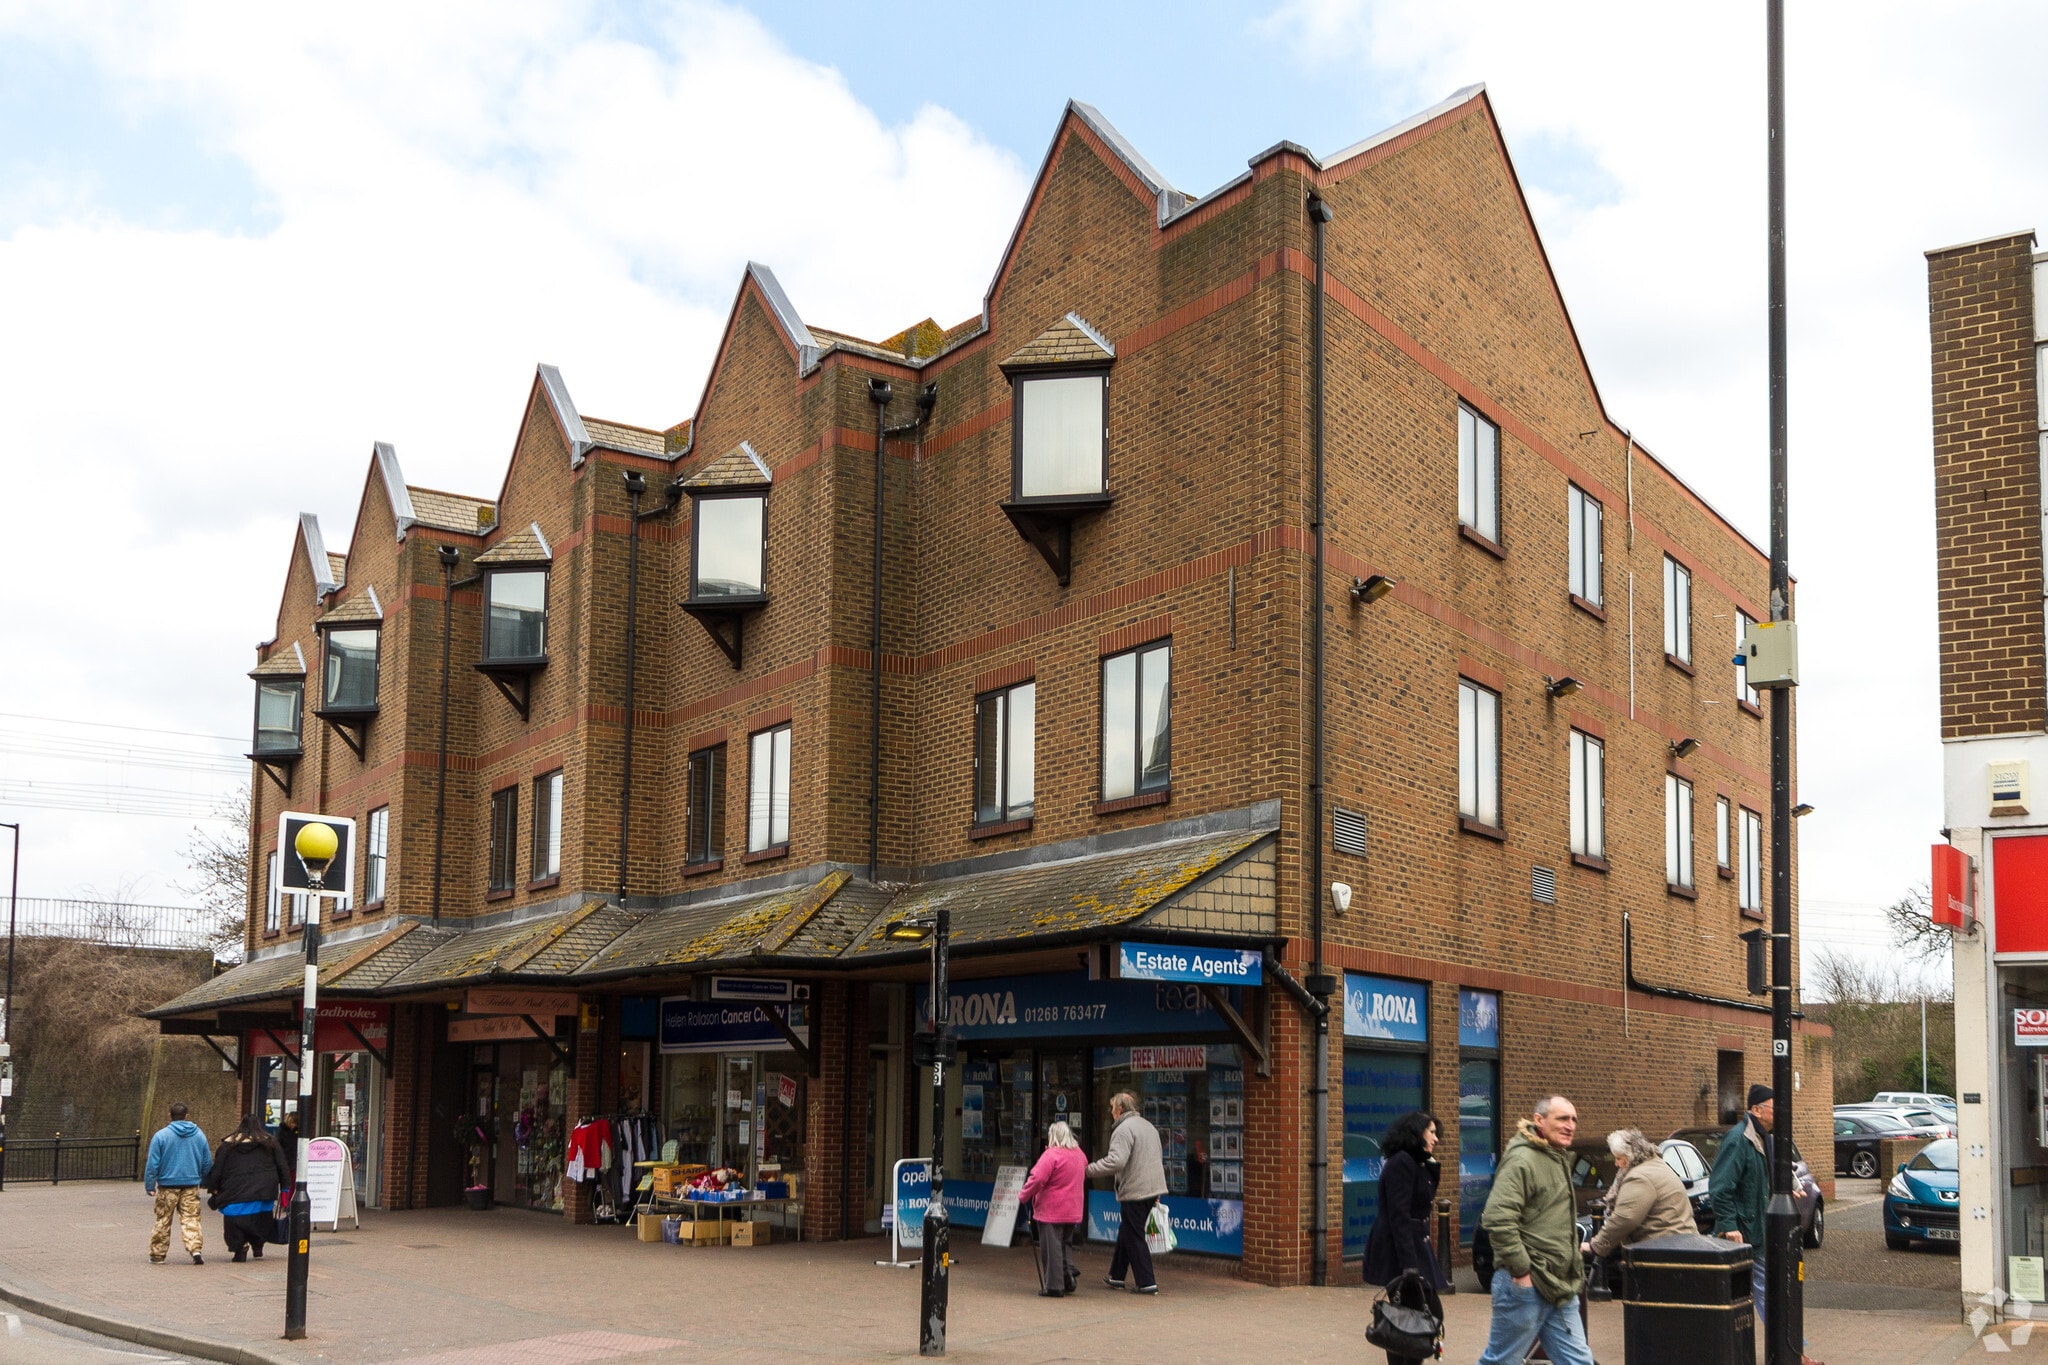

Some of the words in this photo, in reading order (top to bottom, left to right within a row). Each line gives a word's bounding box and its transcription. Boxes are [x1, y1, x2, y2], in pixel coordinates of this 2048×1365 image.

[1137, 951, 1187, 972] Estate
[1191, 954, 1248, 977] Agents
[315, 1006, 377, 1019] Ladbrokes
[664, 1012, 687, 1028] Helen
[688, 1010, 720, 1027] Rollason
[721, 1007, 752, 1024] Cancer
[948, 990, 1018, 1027] RONA
[1025, 1005, 1059, 1022] 01268
[1063, 1003, 1107, 1021] 763477
[1372, 992, 1418, 1025] RONA
[1775, 1041, 1785, 1054] 9
[1132, 1049, 1152, 1069] FREE
[1153, 1046, 1204, 1068] VALUATIONS
[972, 1070, 994, 1082] RONA
[1156, 1071, 1185, 1084] RONA
[779, 1081, 795, 1100] SALE
[671, 1166, 706, 1176] SHARP
